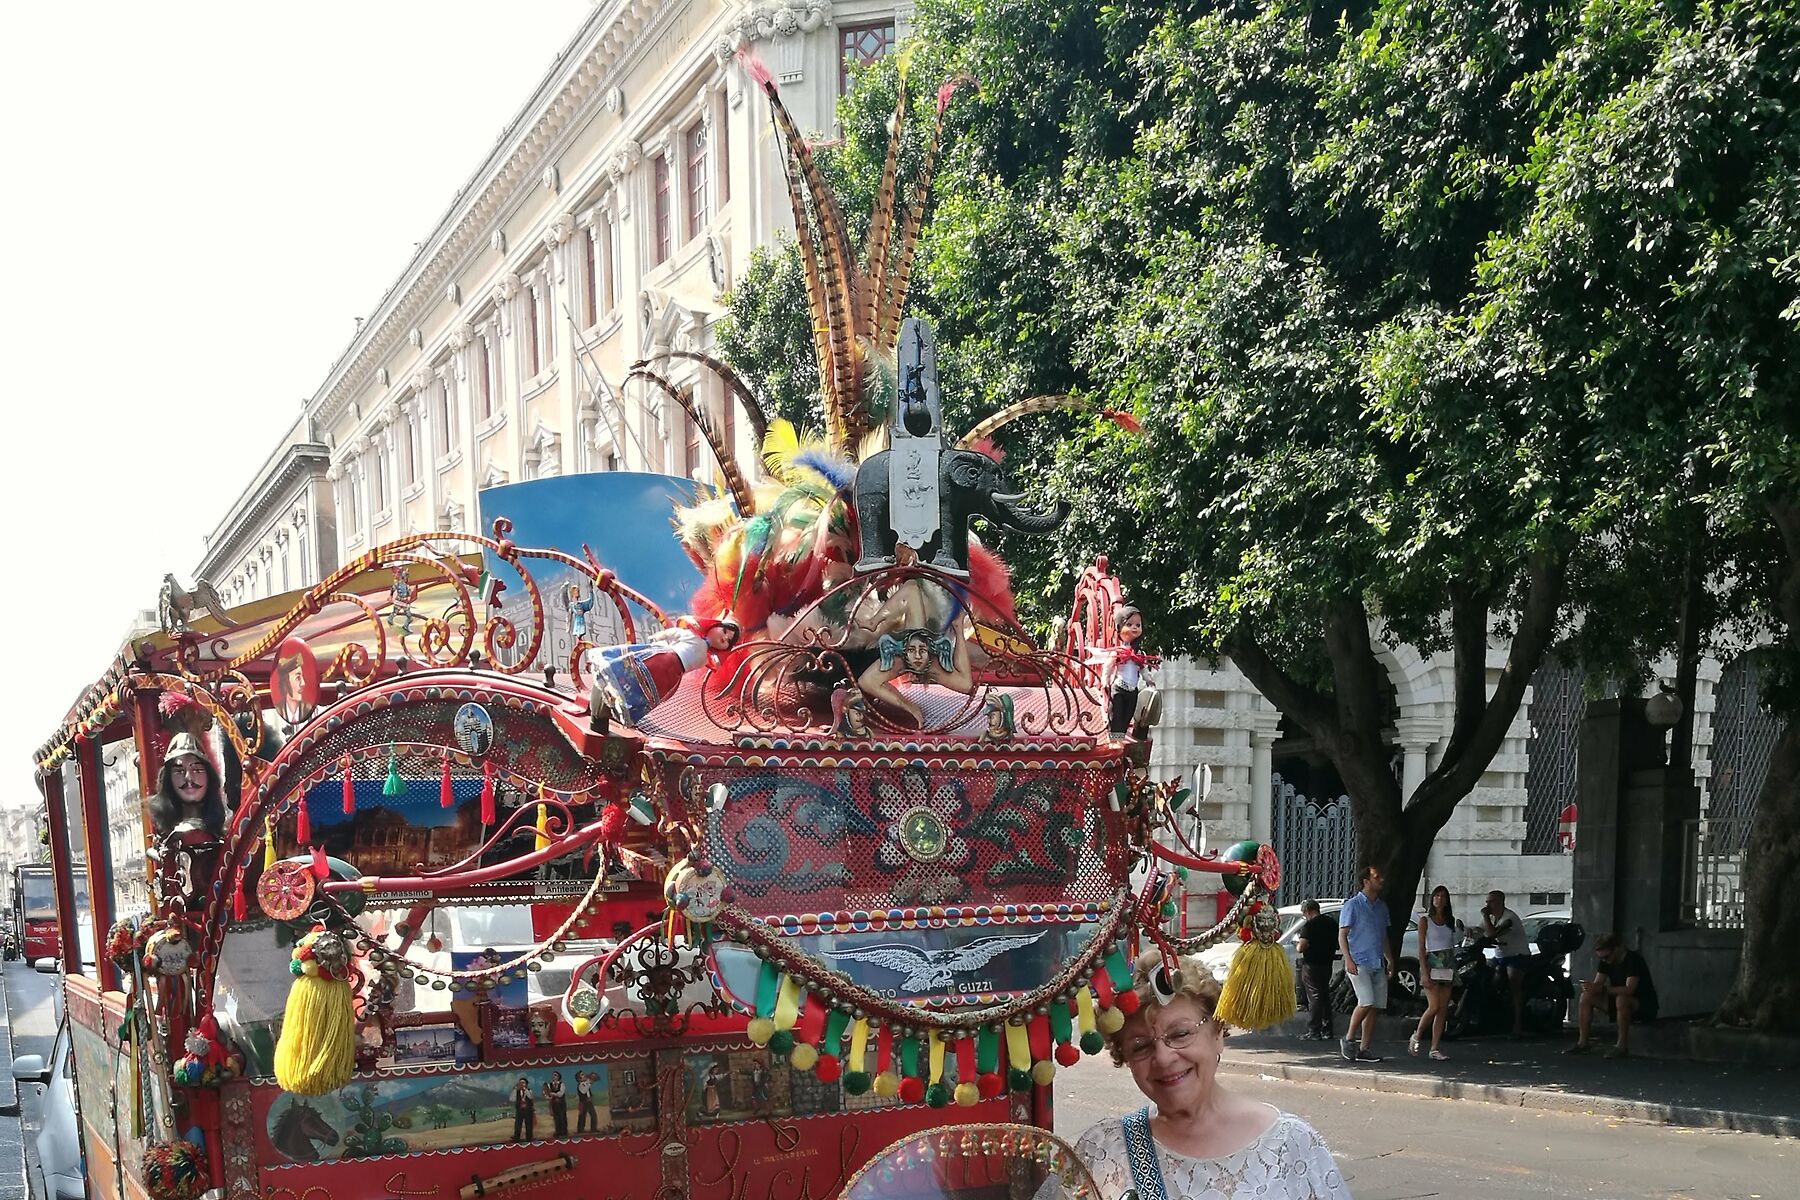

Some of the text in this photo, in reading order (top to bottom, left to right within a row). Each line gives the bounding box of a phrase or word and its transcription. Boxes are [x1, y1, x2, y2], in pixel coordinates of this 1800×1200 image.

[545, 883, 621, 893] Anfiteatro Rmano
[871, 981, 993, 999] OTO GUZZI
